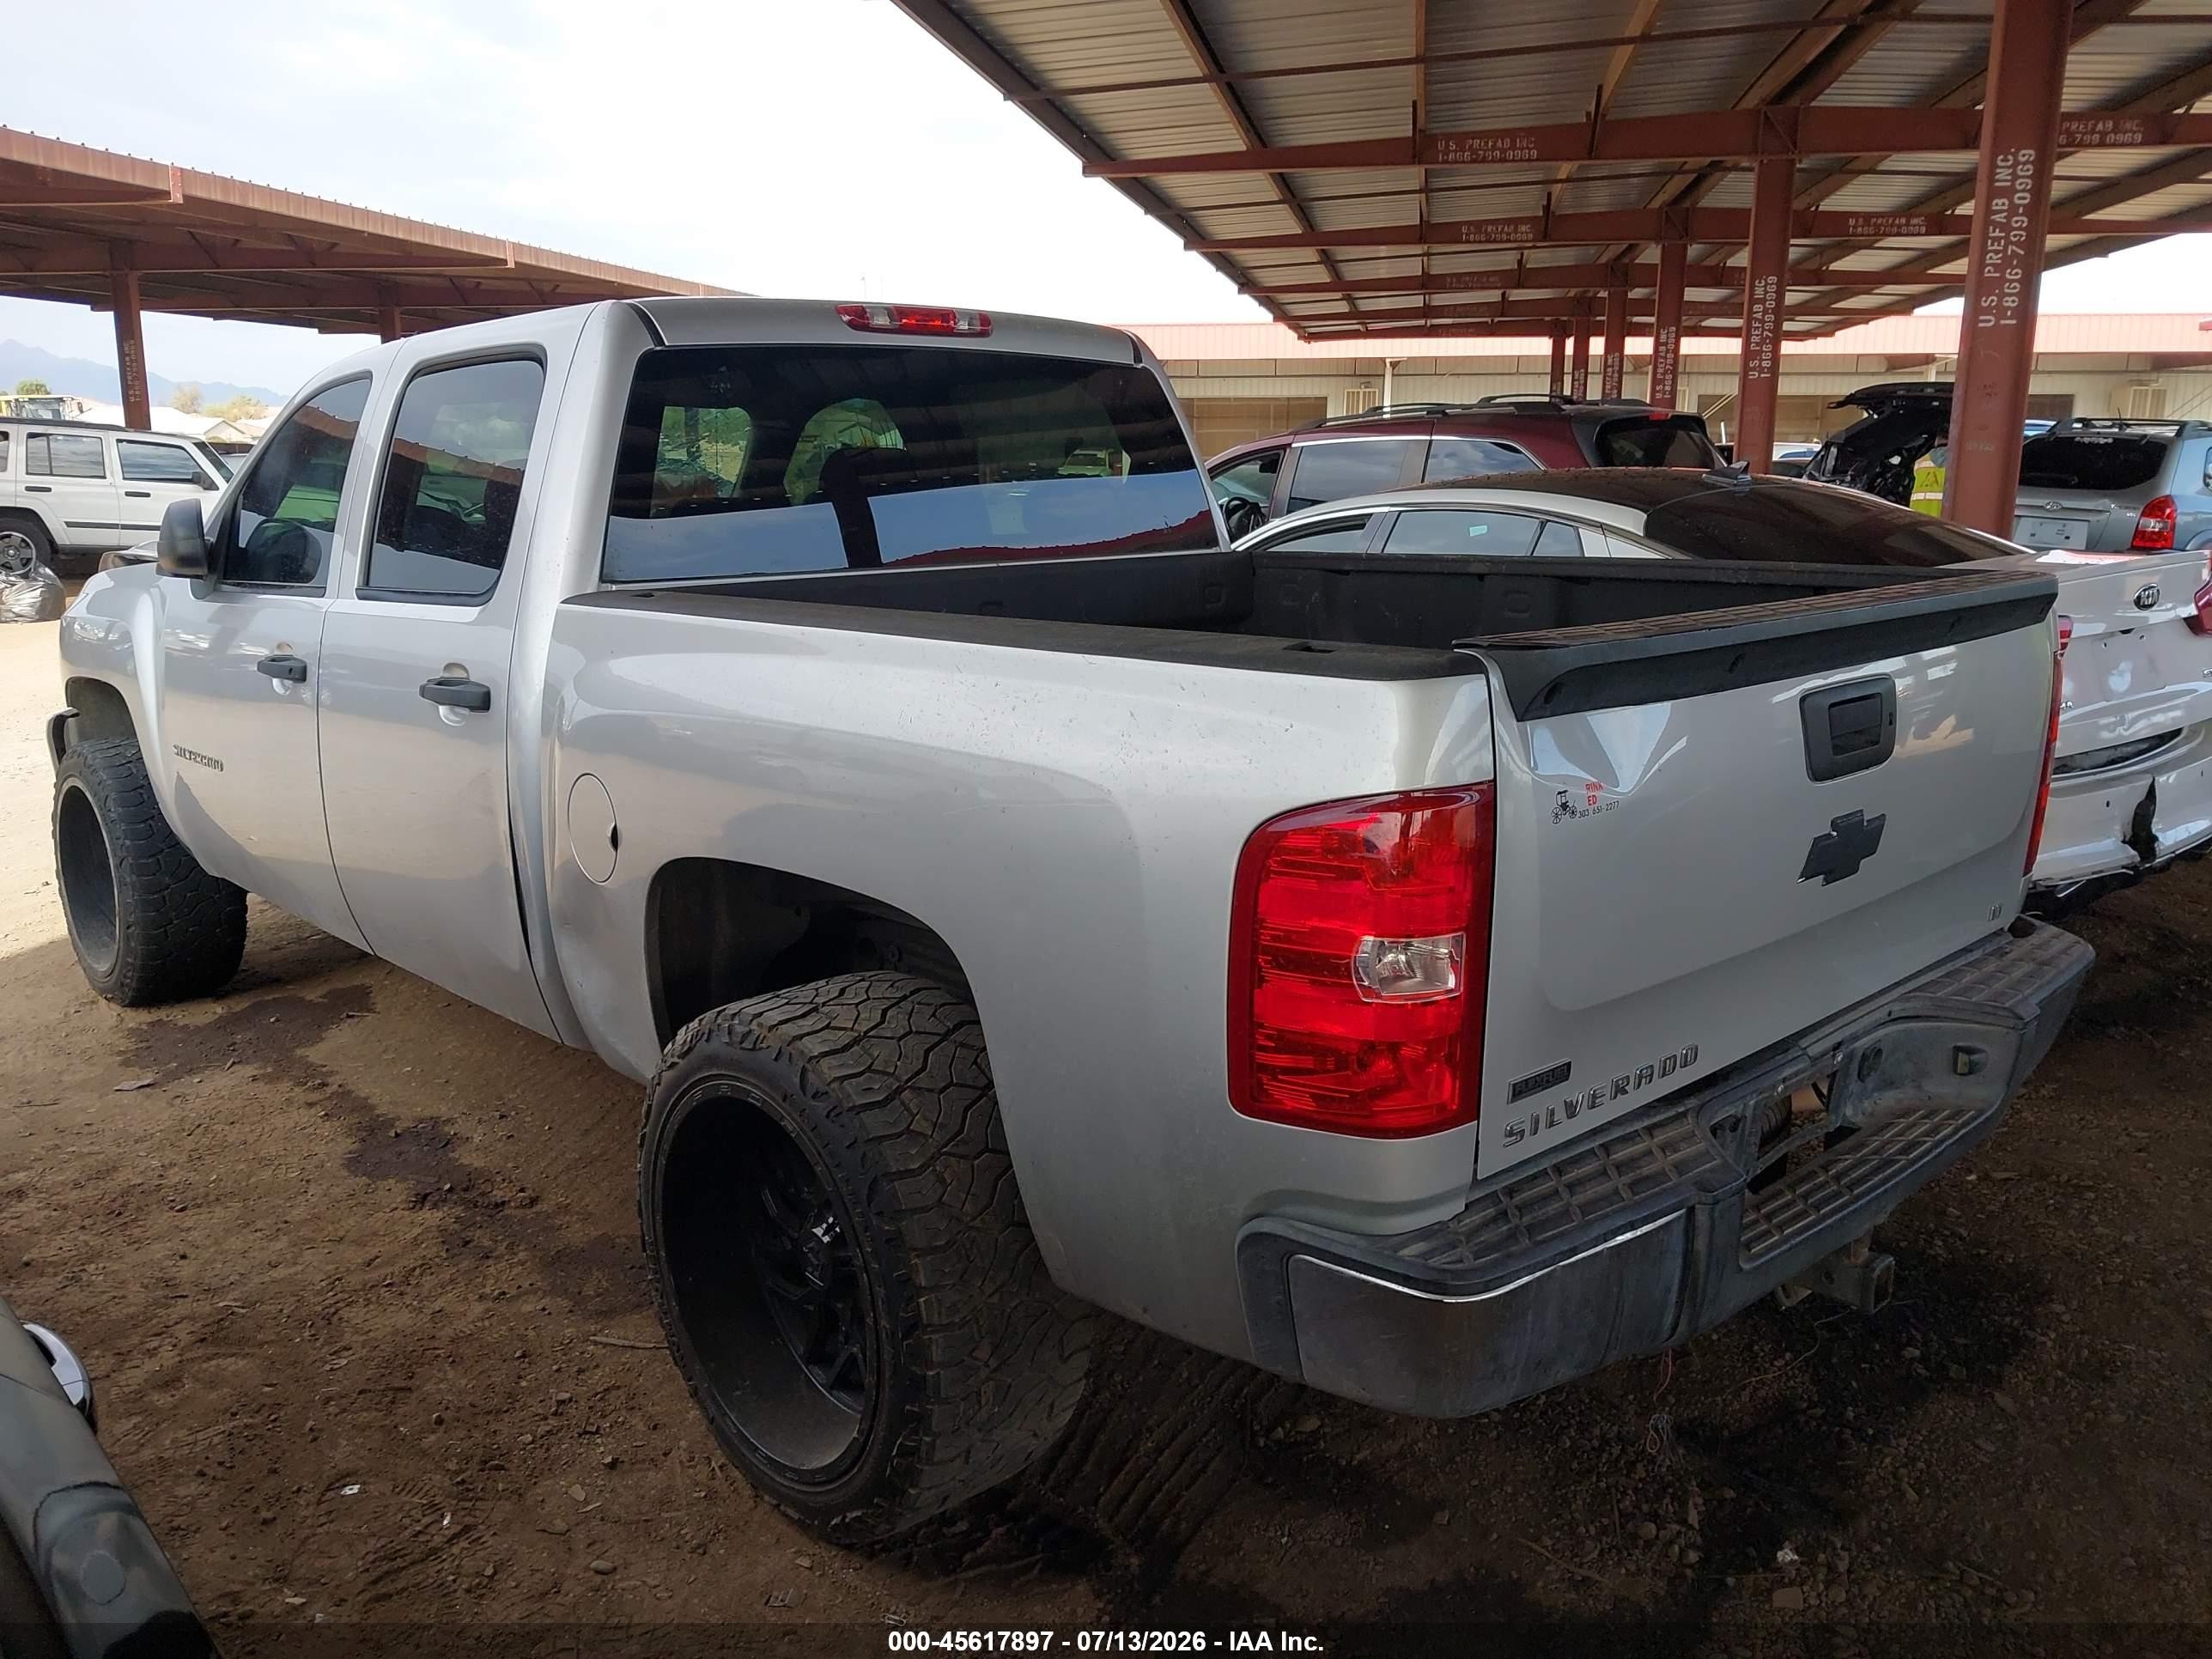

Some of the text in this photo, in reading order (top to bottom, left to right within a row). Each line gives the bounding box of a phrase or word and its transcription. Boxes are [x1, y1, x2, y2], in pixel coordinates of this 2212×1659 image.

[2062, 120, 2113, 131] PREFAB
[1465, 138, 1511, 149] PREFAB
[1437, 149, 1538, 162] 1-866-799-0969
[1870, 216, 1906, 226] PREFAB
[1978, 148, 2015, 327] U.S. PREFAB INC.
[2000, 149, 2036, 325] 1-866-799-0969
[1747, 275, 1766, 379] U.S. PREFAB INC.
[1760, 276, 1778, 378] 1-866-799-0969
[1656, 346, 1667, 379] PREFAB
[1588, 794, 1597, 806] ED
[1578, 809, 1589, 818] 303
[1504, 1042, 1698, 1148] SILVERADO
